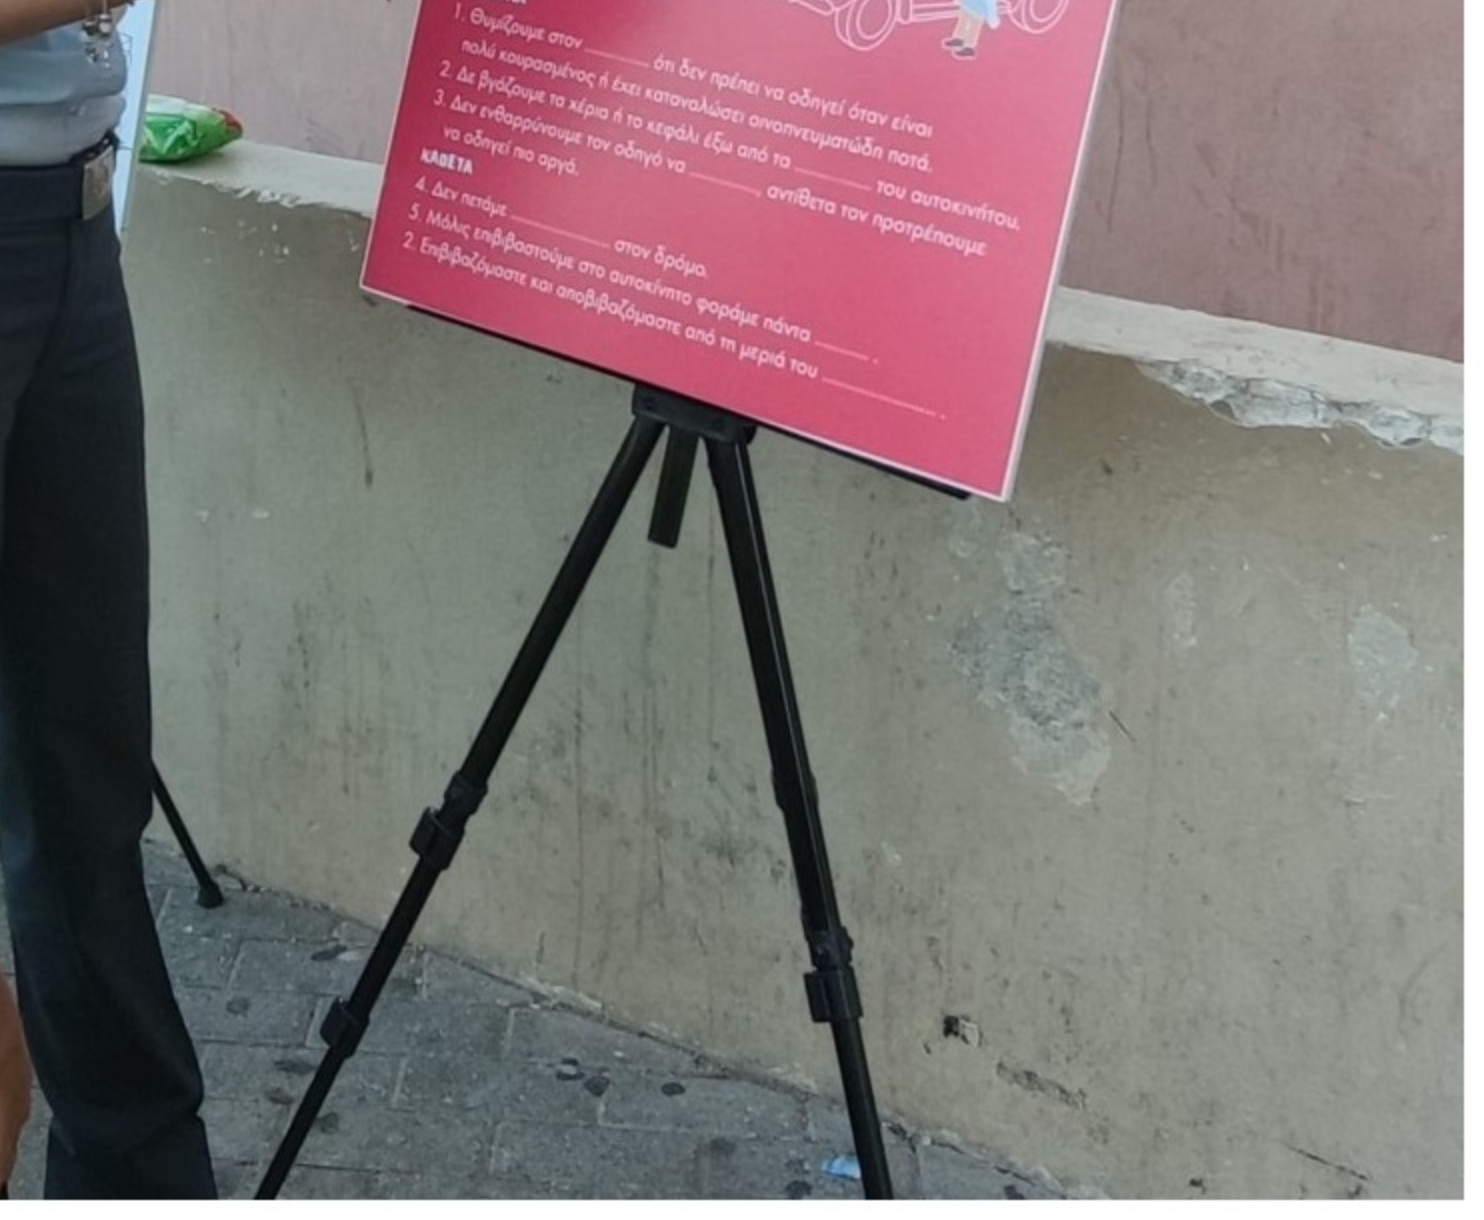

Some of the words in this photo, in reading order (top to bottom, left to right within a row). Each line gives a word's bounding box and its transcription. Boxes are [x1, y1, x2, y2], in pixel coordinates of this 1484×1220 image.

[456, 65, 476, 85] Δε
[478, 68, 547, 105] βγάζουμε
[567, 94, 610, 125] χέρια
[612, 106, 624, 124] ή
[626, 113, 643, 131] το
[646, 117, 699, 148] κεφάλι
[703, 126, 733, 156] έξω
[736, 141, 769, 165] από
[876, 179, 907, 201] του
[461, 38, 497, 60] πολύ
[499, 48, 597, 88] κουρασμένος
[598, 70, 610, 88] ή
[612, 73, 641, 98] έχει
[645, 85, 745, 124] καταναλώσει
[748, 113, 884, 161] οινοπνευματώδη
[887, 146, 933, 173] ποτά.
[469, 7, 546, 43] Θυμίζουμε
[548, 29, 585, 50] στον
[653, 53, 675, 73] ότι
[678, 58, 707, 80] δεν
[710, 69, 761, 96] πρέπει
[764, 83, 784, 101] να
[788, 87, 845, 118] οδηγεί
[848, 103, 889, 126] όταν
[891, 113, 934, 139] είναι
[420, 148, 474, 175] ΚΑΘΕΤΑ
[443, 125, 461, 142] να
[463, 128, 511, 158] οδηγεί
[513, 144, 534, 163] πιο
[538, 152, 580, 177] αργά.
[450, 94, 477, 116] Δεν
[479, 101, 583, 148] ενθαρρύνουμε
[586, 132, 612, 152] τον
[614, 136, 664, 169] οδηγό
[666, 156, 687, 174] να
[766, 184, 836, 216] αντίθετα
[840, 203, 870, 224] τον
[872, 214, 989, 258] προτρέπουμε
[425, 209, 471, 240] Μόλις
[472, 225, 575, 272] επιβιβαστούμε
[577, 260, 606, 280] στο
[609, 267, 693, 306] αυτοκίνητο
[696, 295, 759, 328] φοράμε
[763, 314, 812, 344] πάντα
[431, 181, 458, 203] Δεν
[460, 191, 509, 218] πετάμε
[614, 240, 651, 260] στον
[419, 237, 527, 284] Επιβιβαζόμαστε
[529, 275, 554, 294] και
[555, 282, 682, 337] αποβιβαζόμαστε
[684, 324, 717, 348] από
[720, 335, 736, 352] τη
[739, 341, 787, 370] μεριά
[790, 357, 820, 380] του
